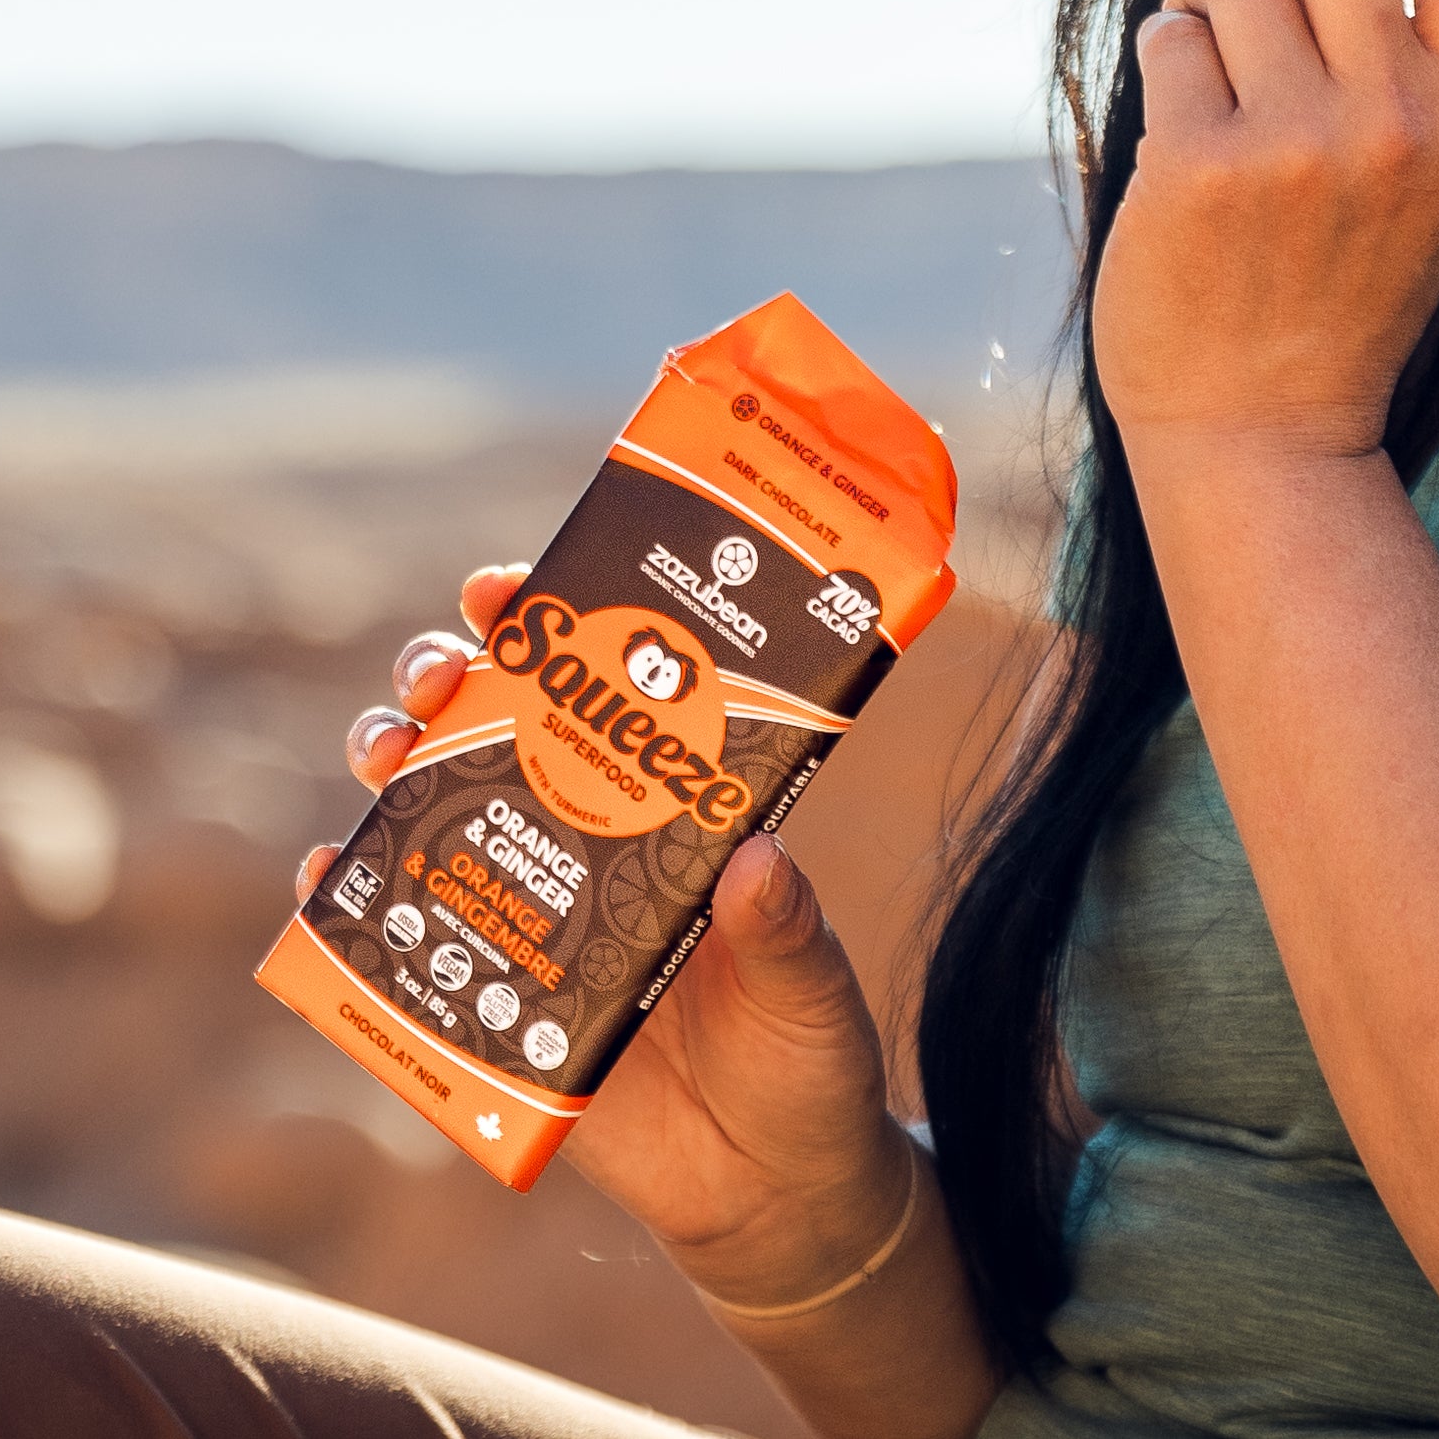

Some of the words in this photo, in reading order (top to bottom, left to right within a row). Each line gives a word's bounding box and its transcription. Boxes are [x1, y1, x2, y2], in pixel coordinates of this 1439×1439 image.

[723, 451, 760, 485] DARK
[760, 479, 843, 549] CHOCOLATE
[759, 416, 823, 468] ORANGE
[820, 464, 834, 480] &
[833, 473, 890, 523] GINGER
[640, 563, 676, 595] ORGANIC
[673, 590, 719, 631] CHOCOLATE
[716, 627, 757, 659] GOODNESS
[647, 543, 768, 649] zazubean
[806, 598, 861, 645] CACAO
[819, 573, 880, 632] 70%
[492, 600, 747, 826] Squeeze
[542, 713, 647, 802] SUPERFOOD
[528, 755, 552, 792] WITH
[550, 789, 612, 828] TURMERIC
[762, 757, 822, 832] QUITABLE
[464, 817, 487, 848] &
[486, 835, 575, 918] GINGER
[486, 798, 589, 891] ORANGE
[398, 912, 419, 933] USDA
[404, 850, 427, 880] &
[426, 868, 565, 992] GINGEMBRE
[431, 903, 462, 933] AVEC
[460, 928, 511, 974] CURCUMA
[450, 851, 553, 944] ORANGE
[394, 967, 409, 984] 3
[428, 995, 449, 1017] 85
[442, 1012, 458, 1029] g
[438, 953, 468, 984] VEGAN
[483, 994, 515, 1021] GLUTEN
[495, 989, 516, 1009] SANS
[639, 919, 708, 1011] BIOLOGIQUE
[339, 1003, 415, 1070] CHOCOLAT
[415, 1065, 451, 1103] NOIR
[483, 1006, 503, 1025] FREE
